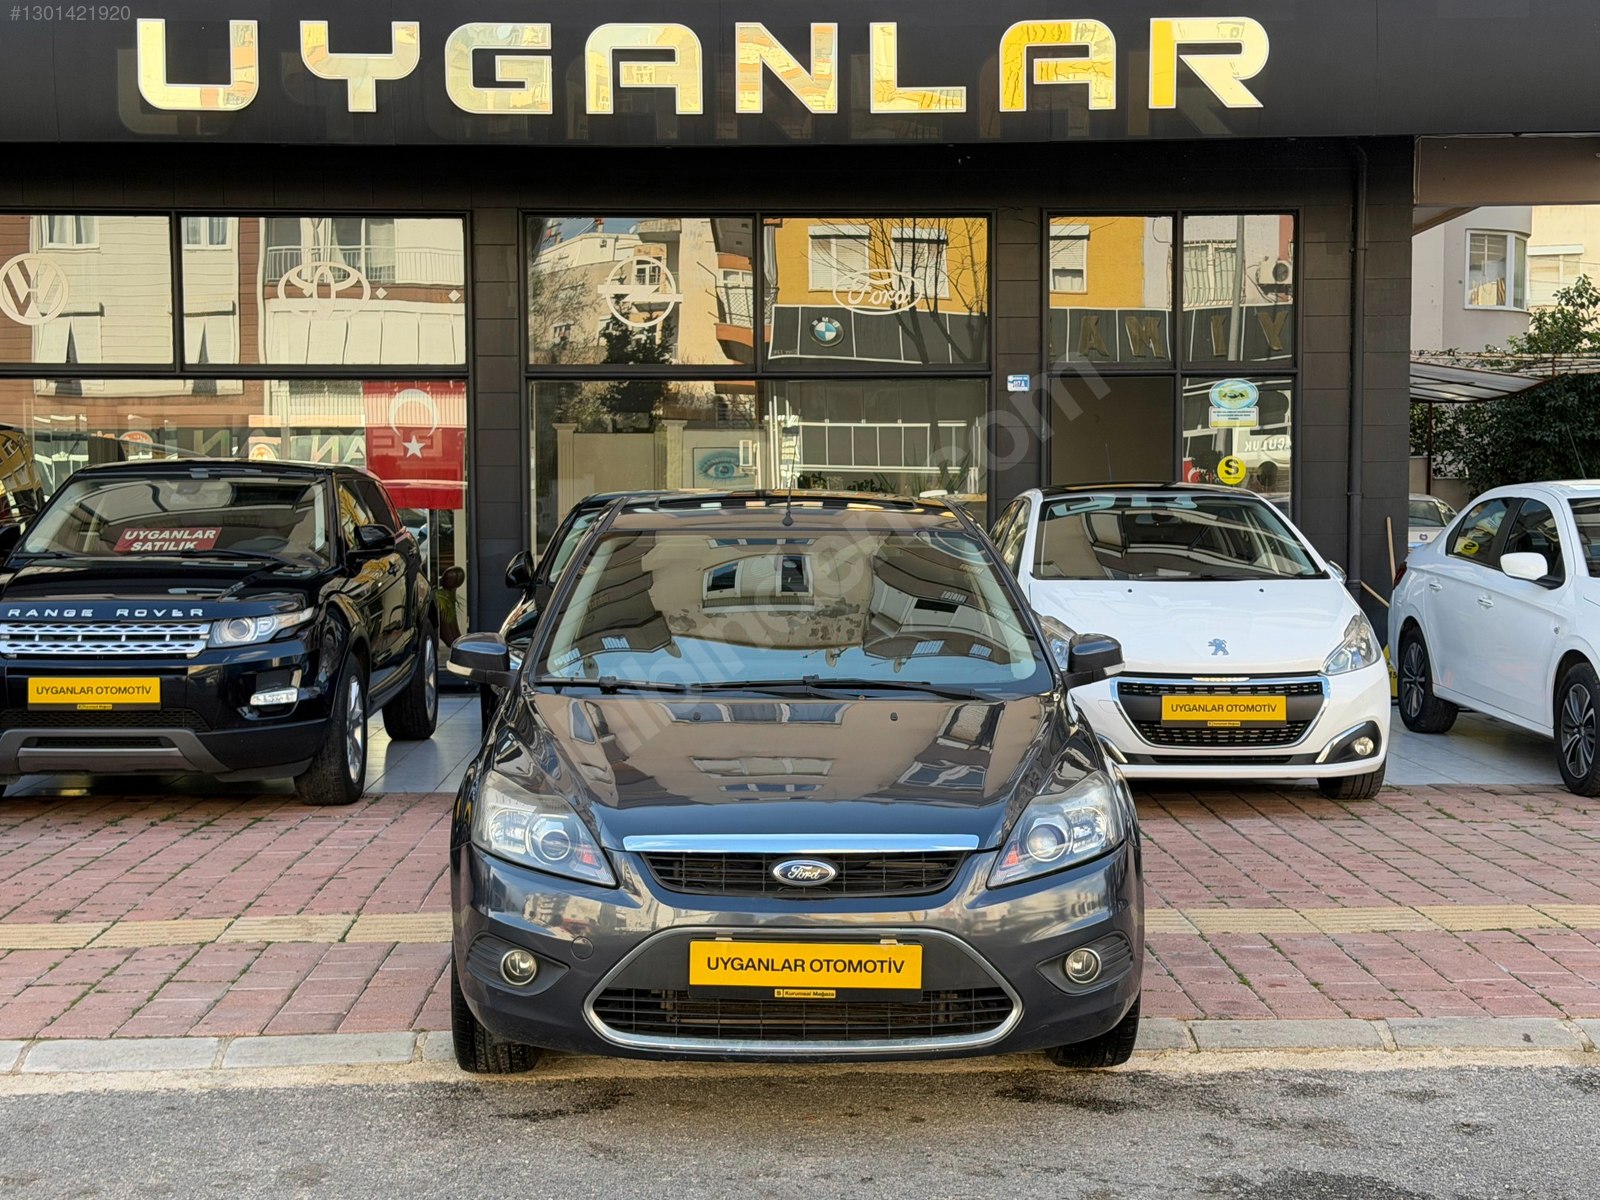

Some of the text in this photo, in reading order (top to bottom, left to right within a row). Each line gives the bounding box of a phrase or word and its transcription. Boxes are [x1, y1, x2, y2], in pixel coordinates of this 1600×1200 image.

[136, 16, 1270, 115] UYGANLAR
[1224, 458, 1240, 476] S
[124, 530, 216, 540] UYGANLAR
[130, 541, 199, 551] SATILIK
[7, 608, 204, 617] RANGE ROVER
[36, 683, 152, 695] UYGANLAR OTOMOTİV
[1171, 702, 1278, 713] UYGANLAR OTOMOTİV
[787, 864, 822, 881] Ford
[706, 956, 906, 974] UYGANLAR OTOMOTİV
